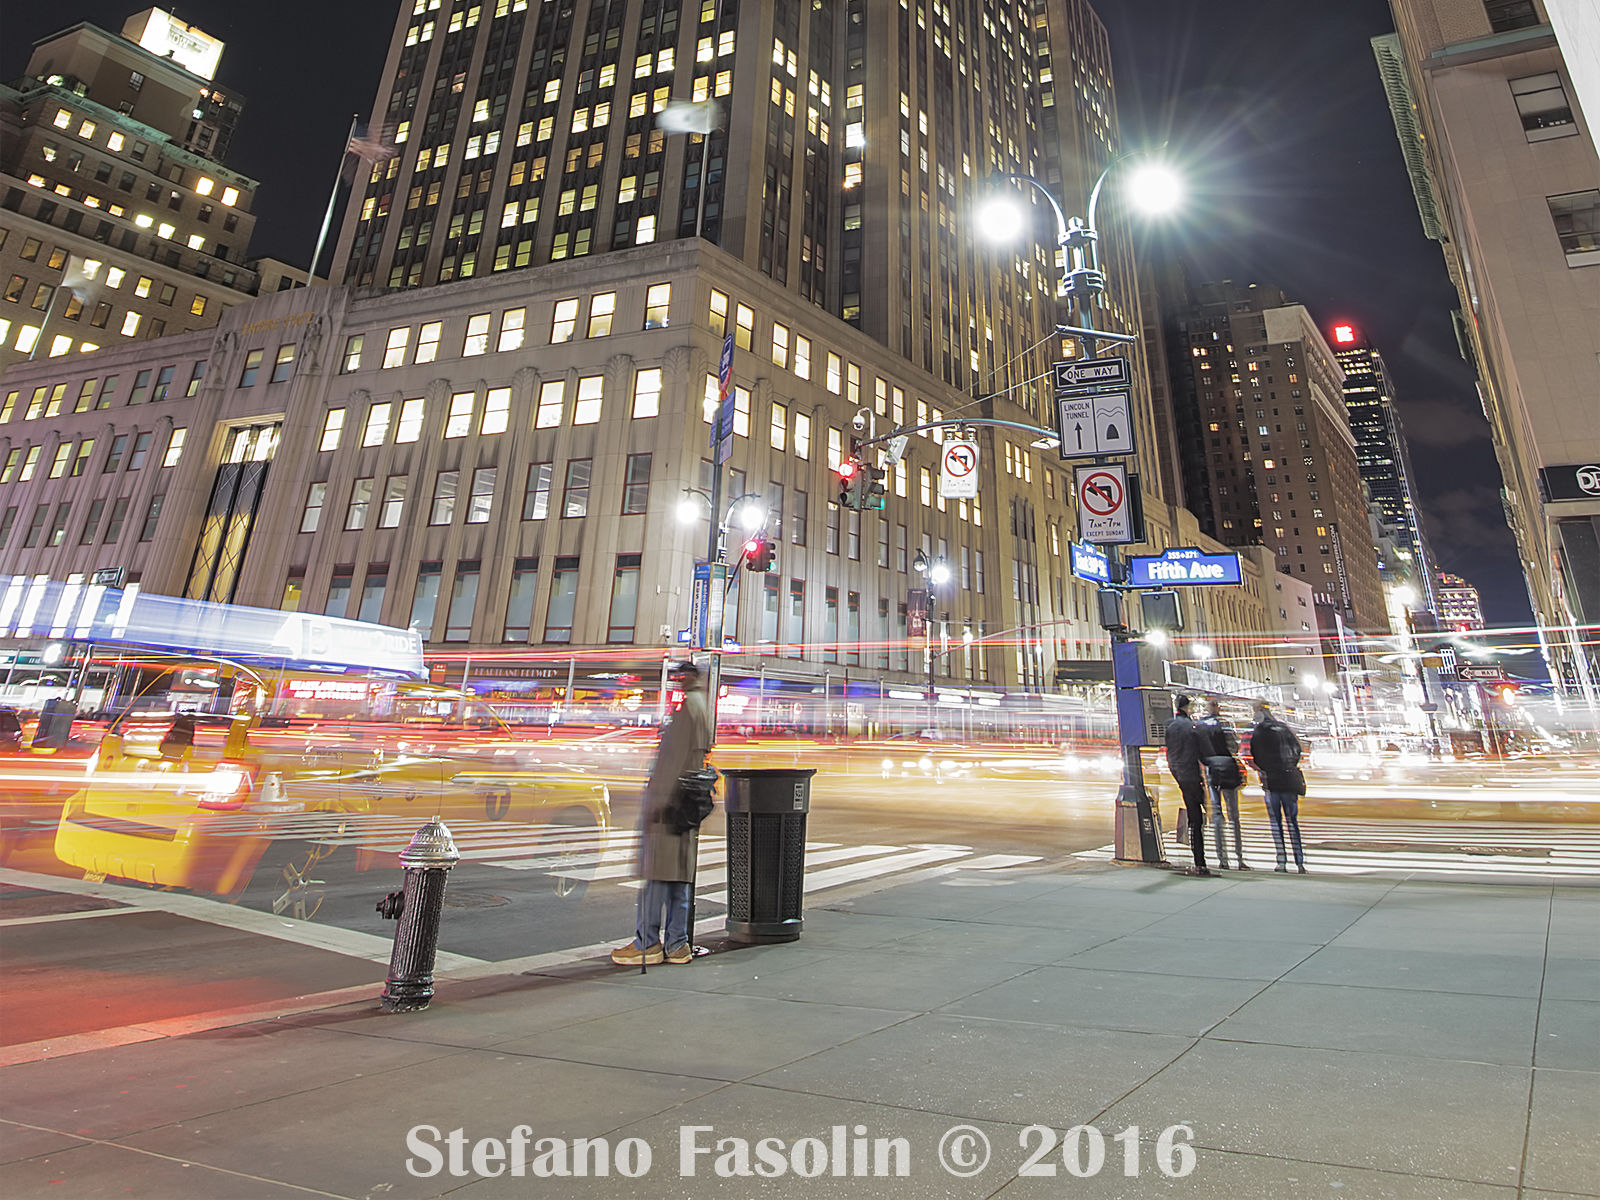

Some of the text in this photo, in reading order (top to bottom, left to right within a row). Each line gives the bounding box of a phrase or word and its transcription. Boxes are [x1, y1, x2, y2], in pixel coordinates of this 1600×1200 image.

[1067, 366, 1113, 380] ONE WAY
[1064, 402, 1090, 412] LINCOLN
[1066, 411, 1089, 420] TUNNEL
[1147, 560, 1224, 580] Fifth Ave
